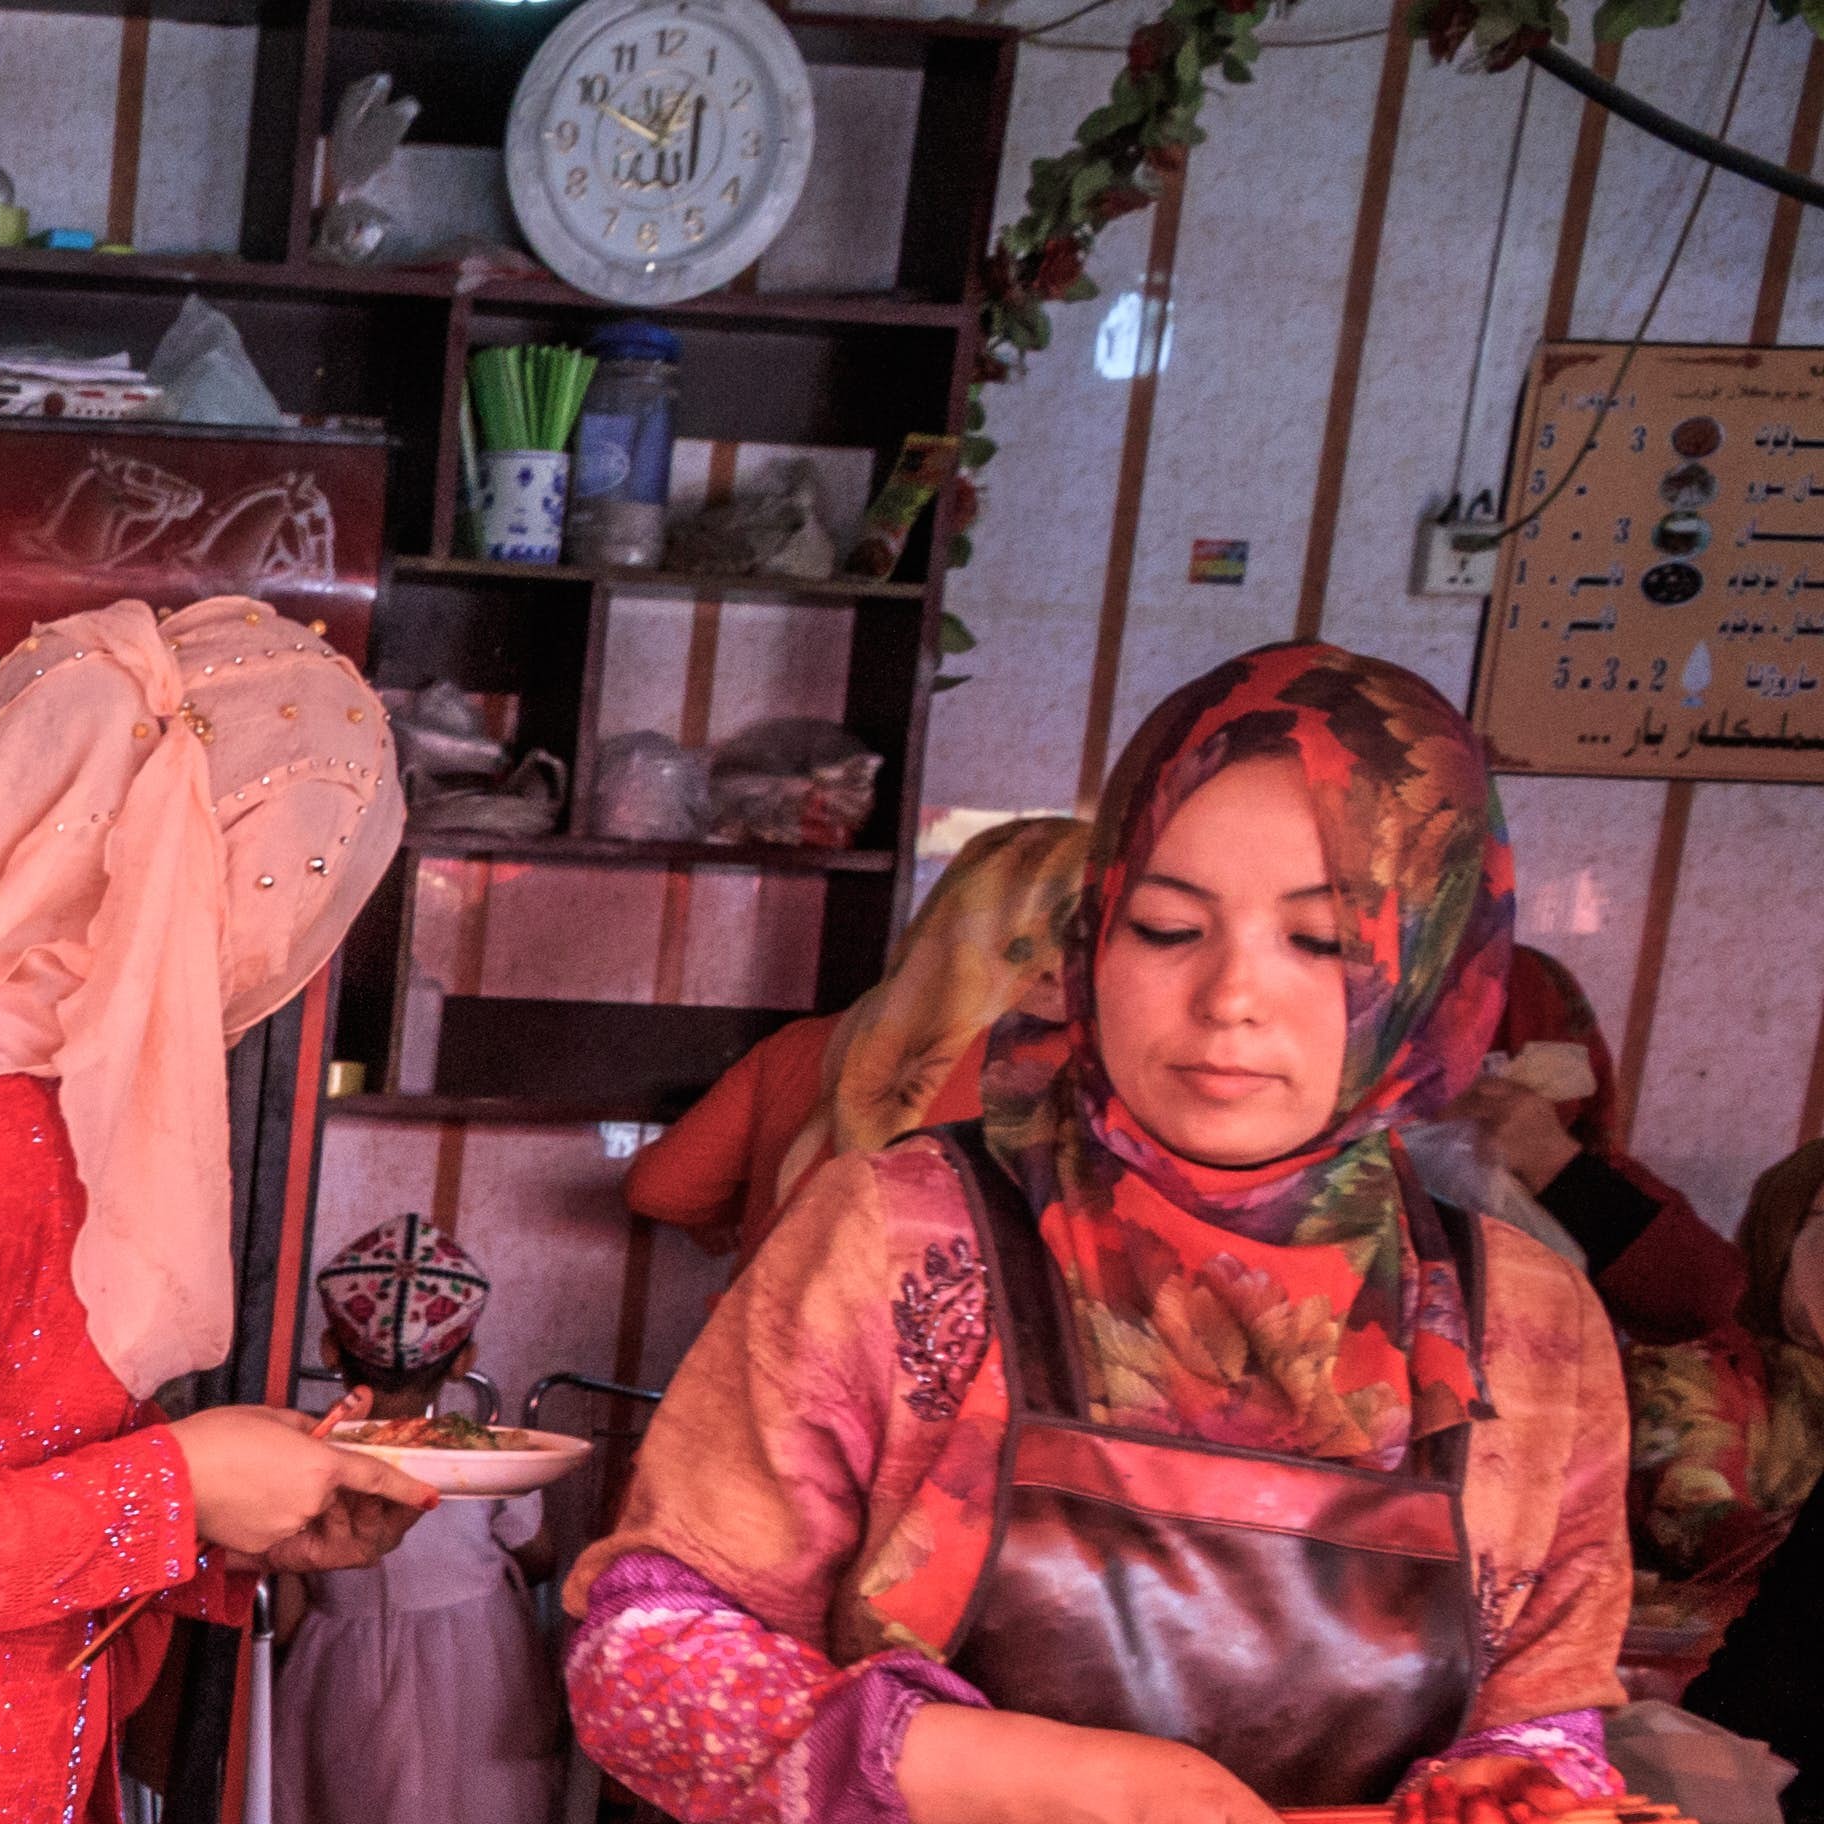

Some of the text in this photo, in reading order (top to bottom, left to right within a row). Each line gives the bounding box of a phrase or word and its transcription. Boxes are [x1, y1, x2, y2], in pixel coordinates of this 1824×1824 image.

[614, 44, 637, 72] 11
[655, 28, 689, 58] 12
[705, 45, 718, 76] 1
[577, 73, 609, 105] 10
[730, 77, 753, 112] 2
[554, 120, 580, 154] 9
[740, 128, 762, 160] 3
[563, 166, 589, 201] 8
[721, 175, 741, 209] 4
[602, 207, 620, 239] 7
[636, 220, 659, 254] 6
[682, 206, 706, 242] 5
[1539, 423, 1648, 452] 5 3
[1529, 469, 1547, 494] 5
[1614, 517, 1632, 544] 3
[1552, 656, 1668, 692] 5.3.2
